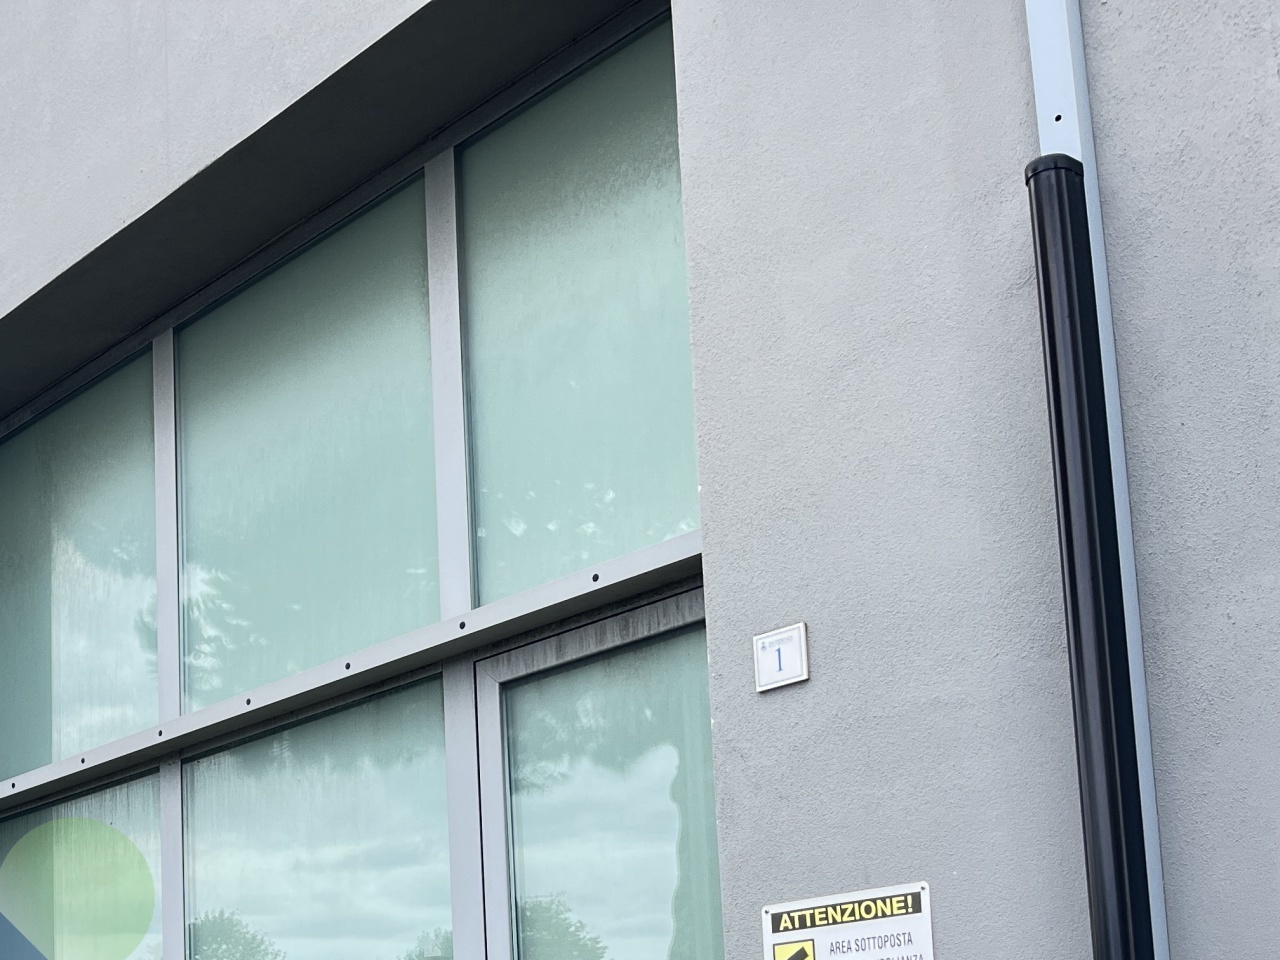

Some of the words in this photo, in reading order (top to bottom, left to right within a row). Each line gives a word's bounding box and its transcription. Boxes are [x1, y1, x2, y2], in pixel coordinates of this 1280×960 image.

[775, 647, 783, 672] 1
[779, 894, 913, 931] ATTENZIONE!
[829, 938, 853, 956] AREA
[854, 931, 913, 952] SOTTOPOSTA
